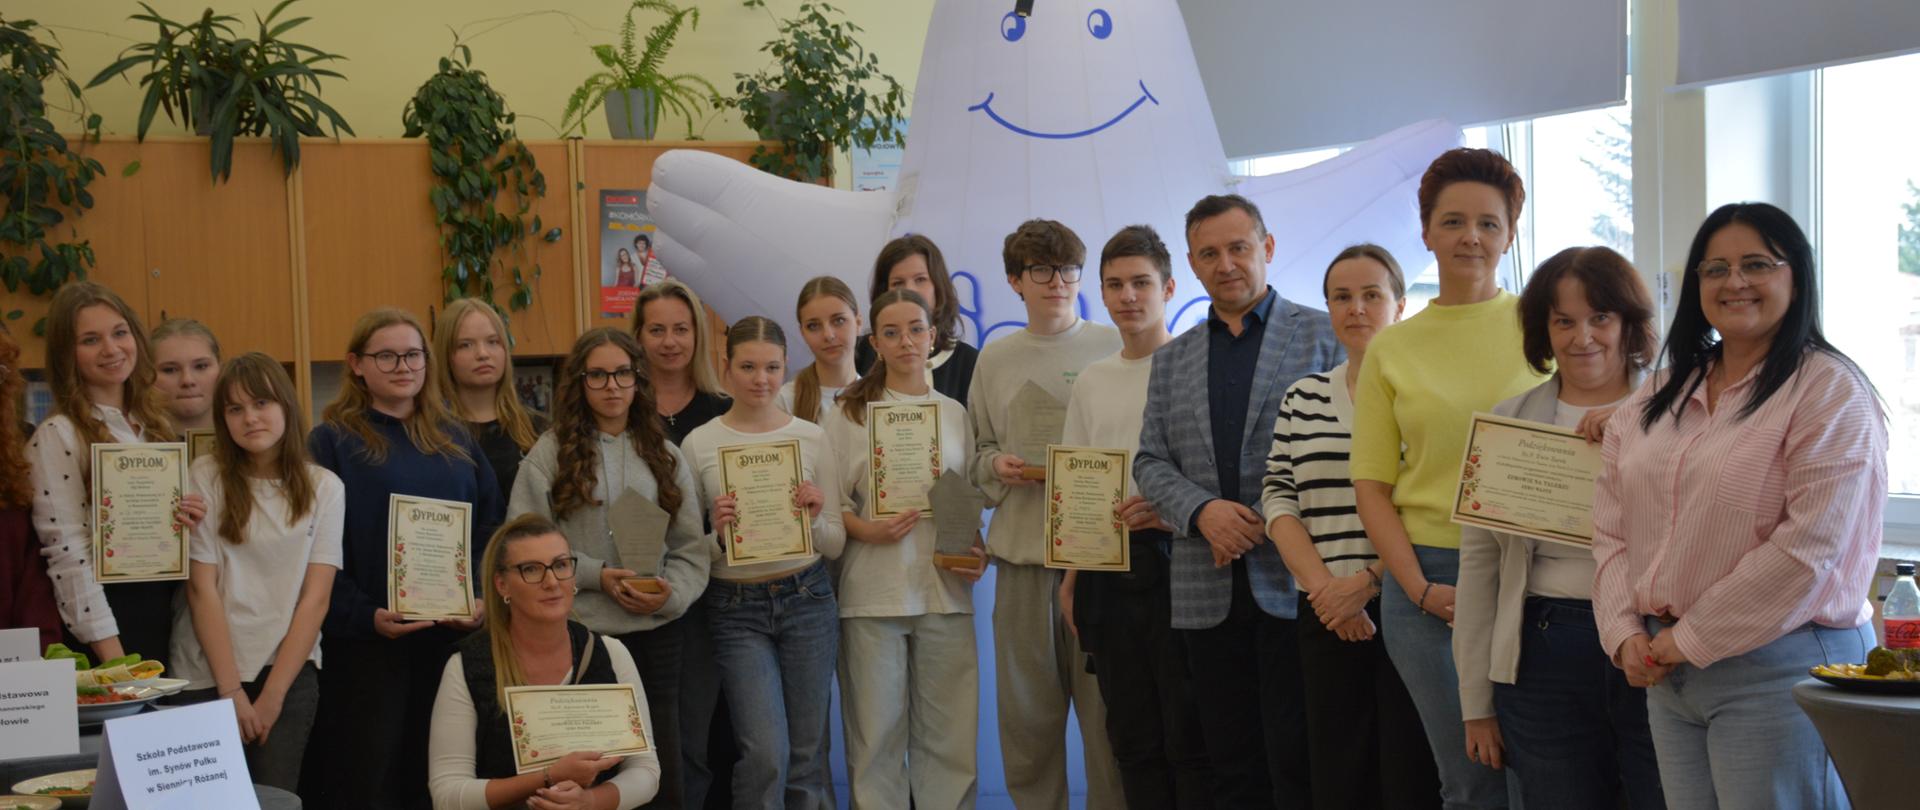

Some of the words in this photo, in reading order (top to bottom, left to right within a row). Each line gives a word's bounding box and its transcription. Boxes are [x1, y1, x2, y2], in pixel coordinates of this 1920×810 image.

[887, 411, 923, 424] DYPLOM
[118, 455, 164, 470] DYPLOM
[740, 453, 779, 467] DYPLOM
[1069, 457, 1108, 470] DYPLOM
[412, 508, 450, 522] DYPLOM
[136, 749, 166, 762] Szkoła
[167, 739, 221, 756] Podstawowa
[148, 767, 162, 777] im.
[163, 759, 192, 774] Synów
[193, 756, 217, 767] Pułku
[146, 786, 155, 794] w
[194, 769, 228, 784] Różanej
